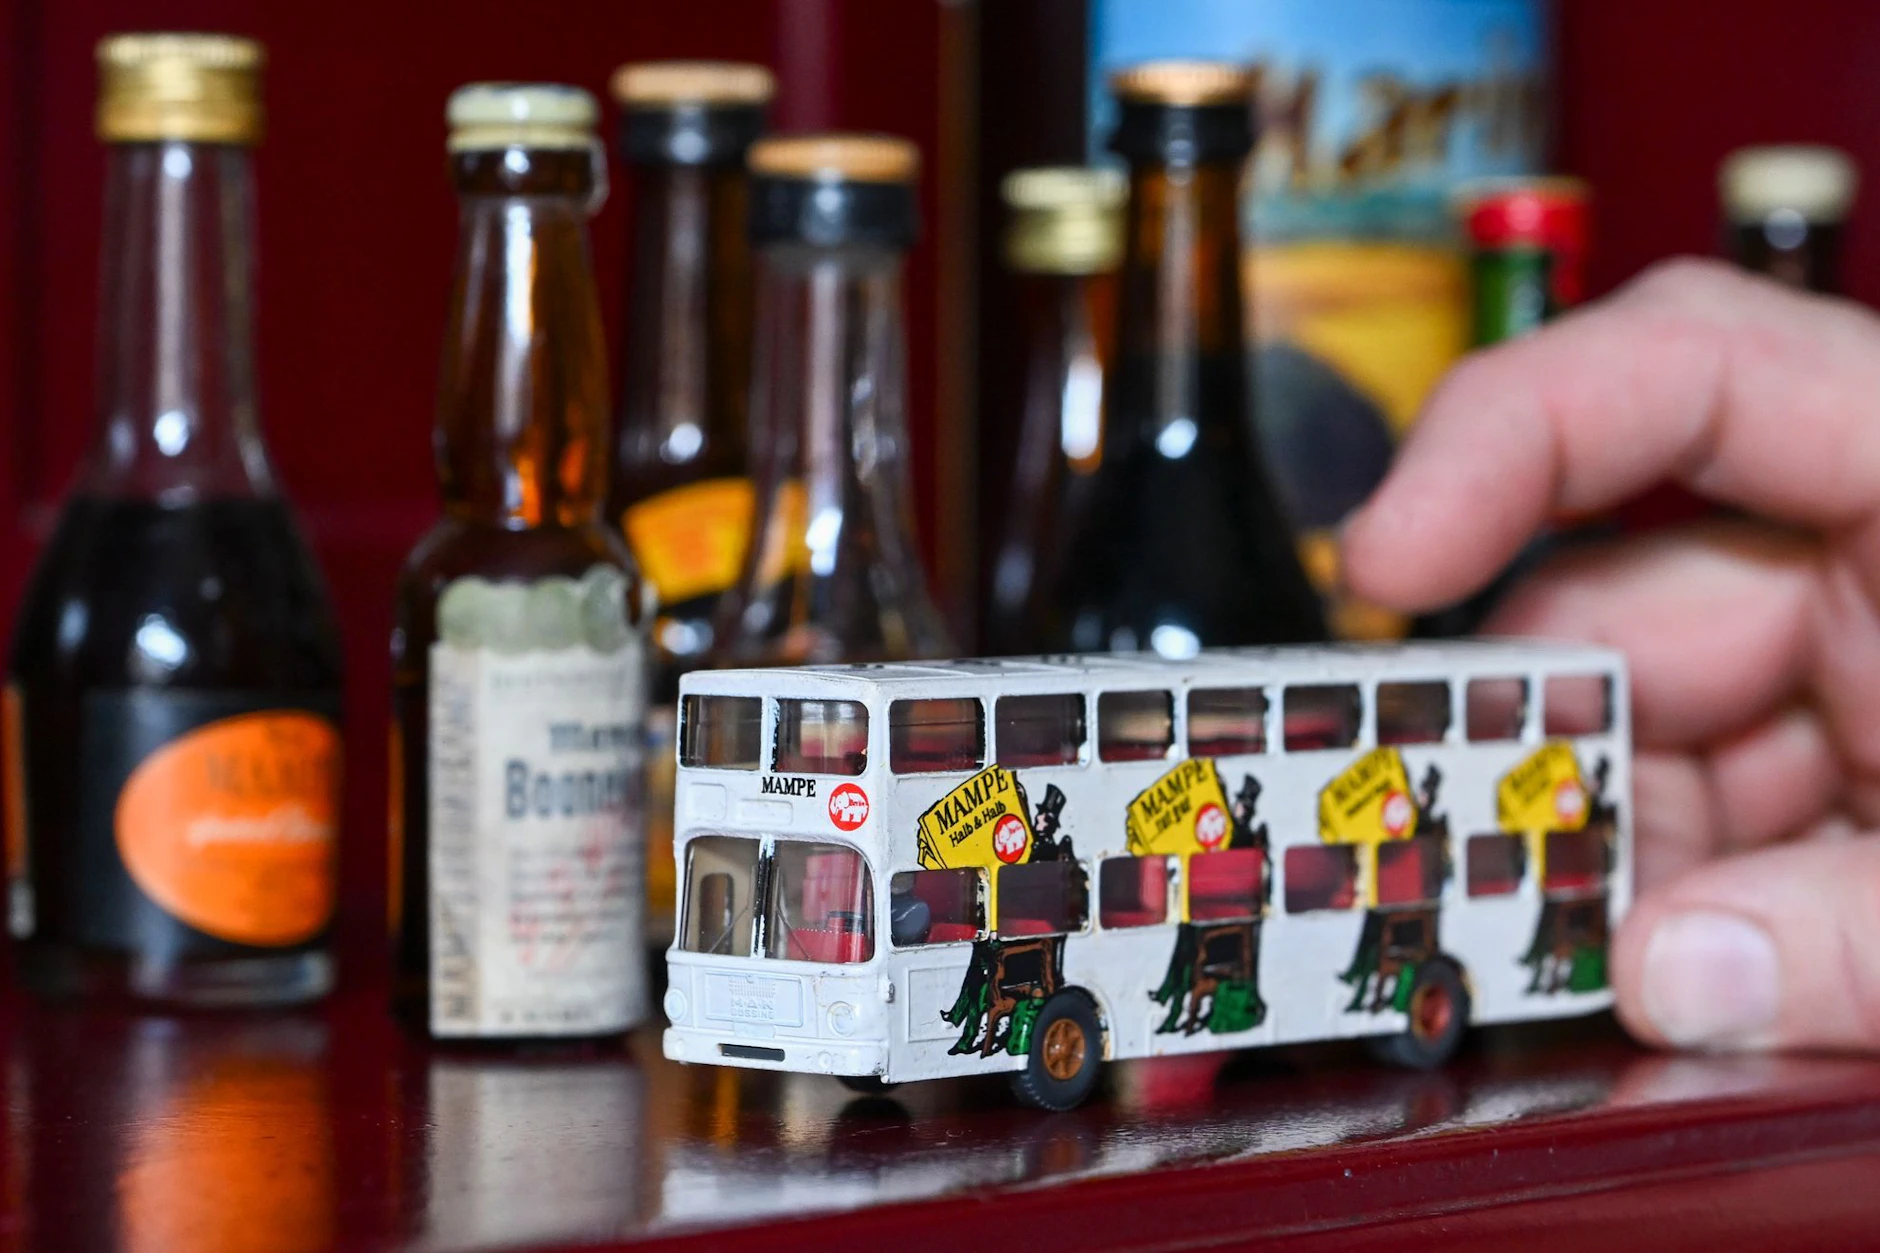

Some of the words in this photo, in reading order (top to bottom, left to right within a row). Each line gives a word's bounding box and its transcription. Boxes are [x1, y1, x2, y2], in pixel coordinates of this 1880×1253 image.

[761, 776, 816, 797] MAMPE
[934, 767, 1009, 835] MAMPE
[949, 822, 974, 848] Halb
[974, 815, 983, 830] &
[981, 800, 1007, 824] Halb
